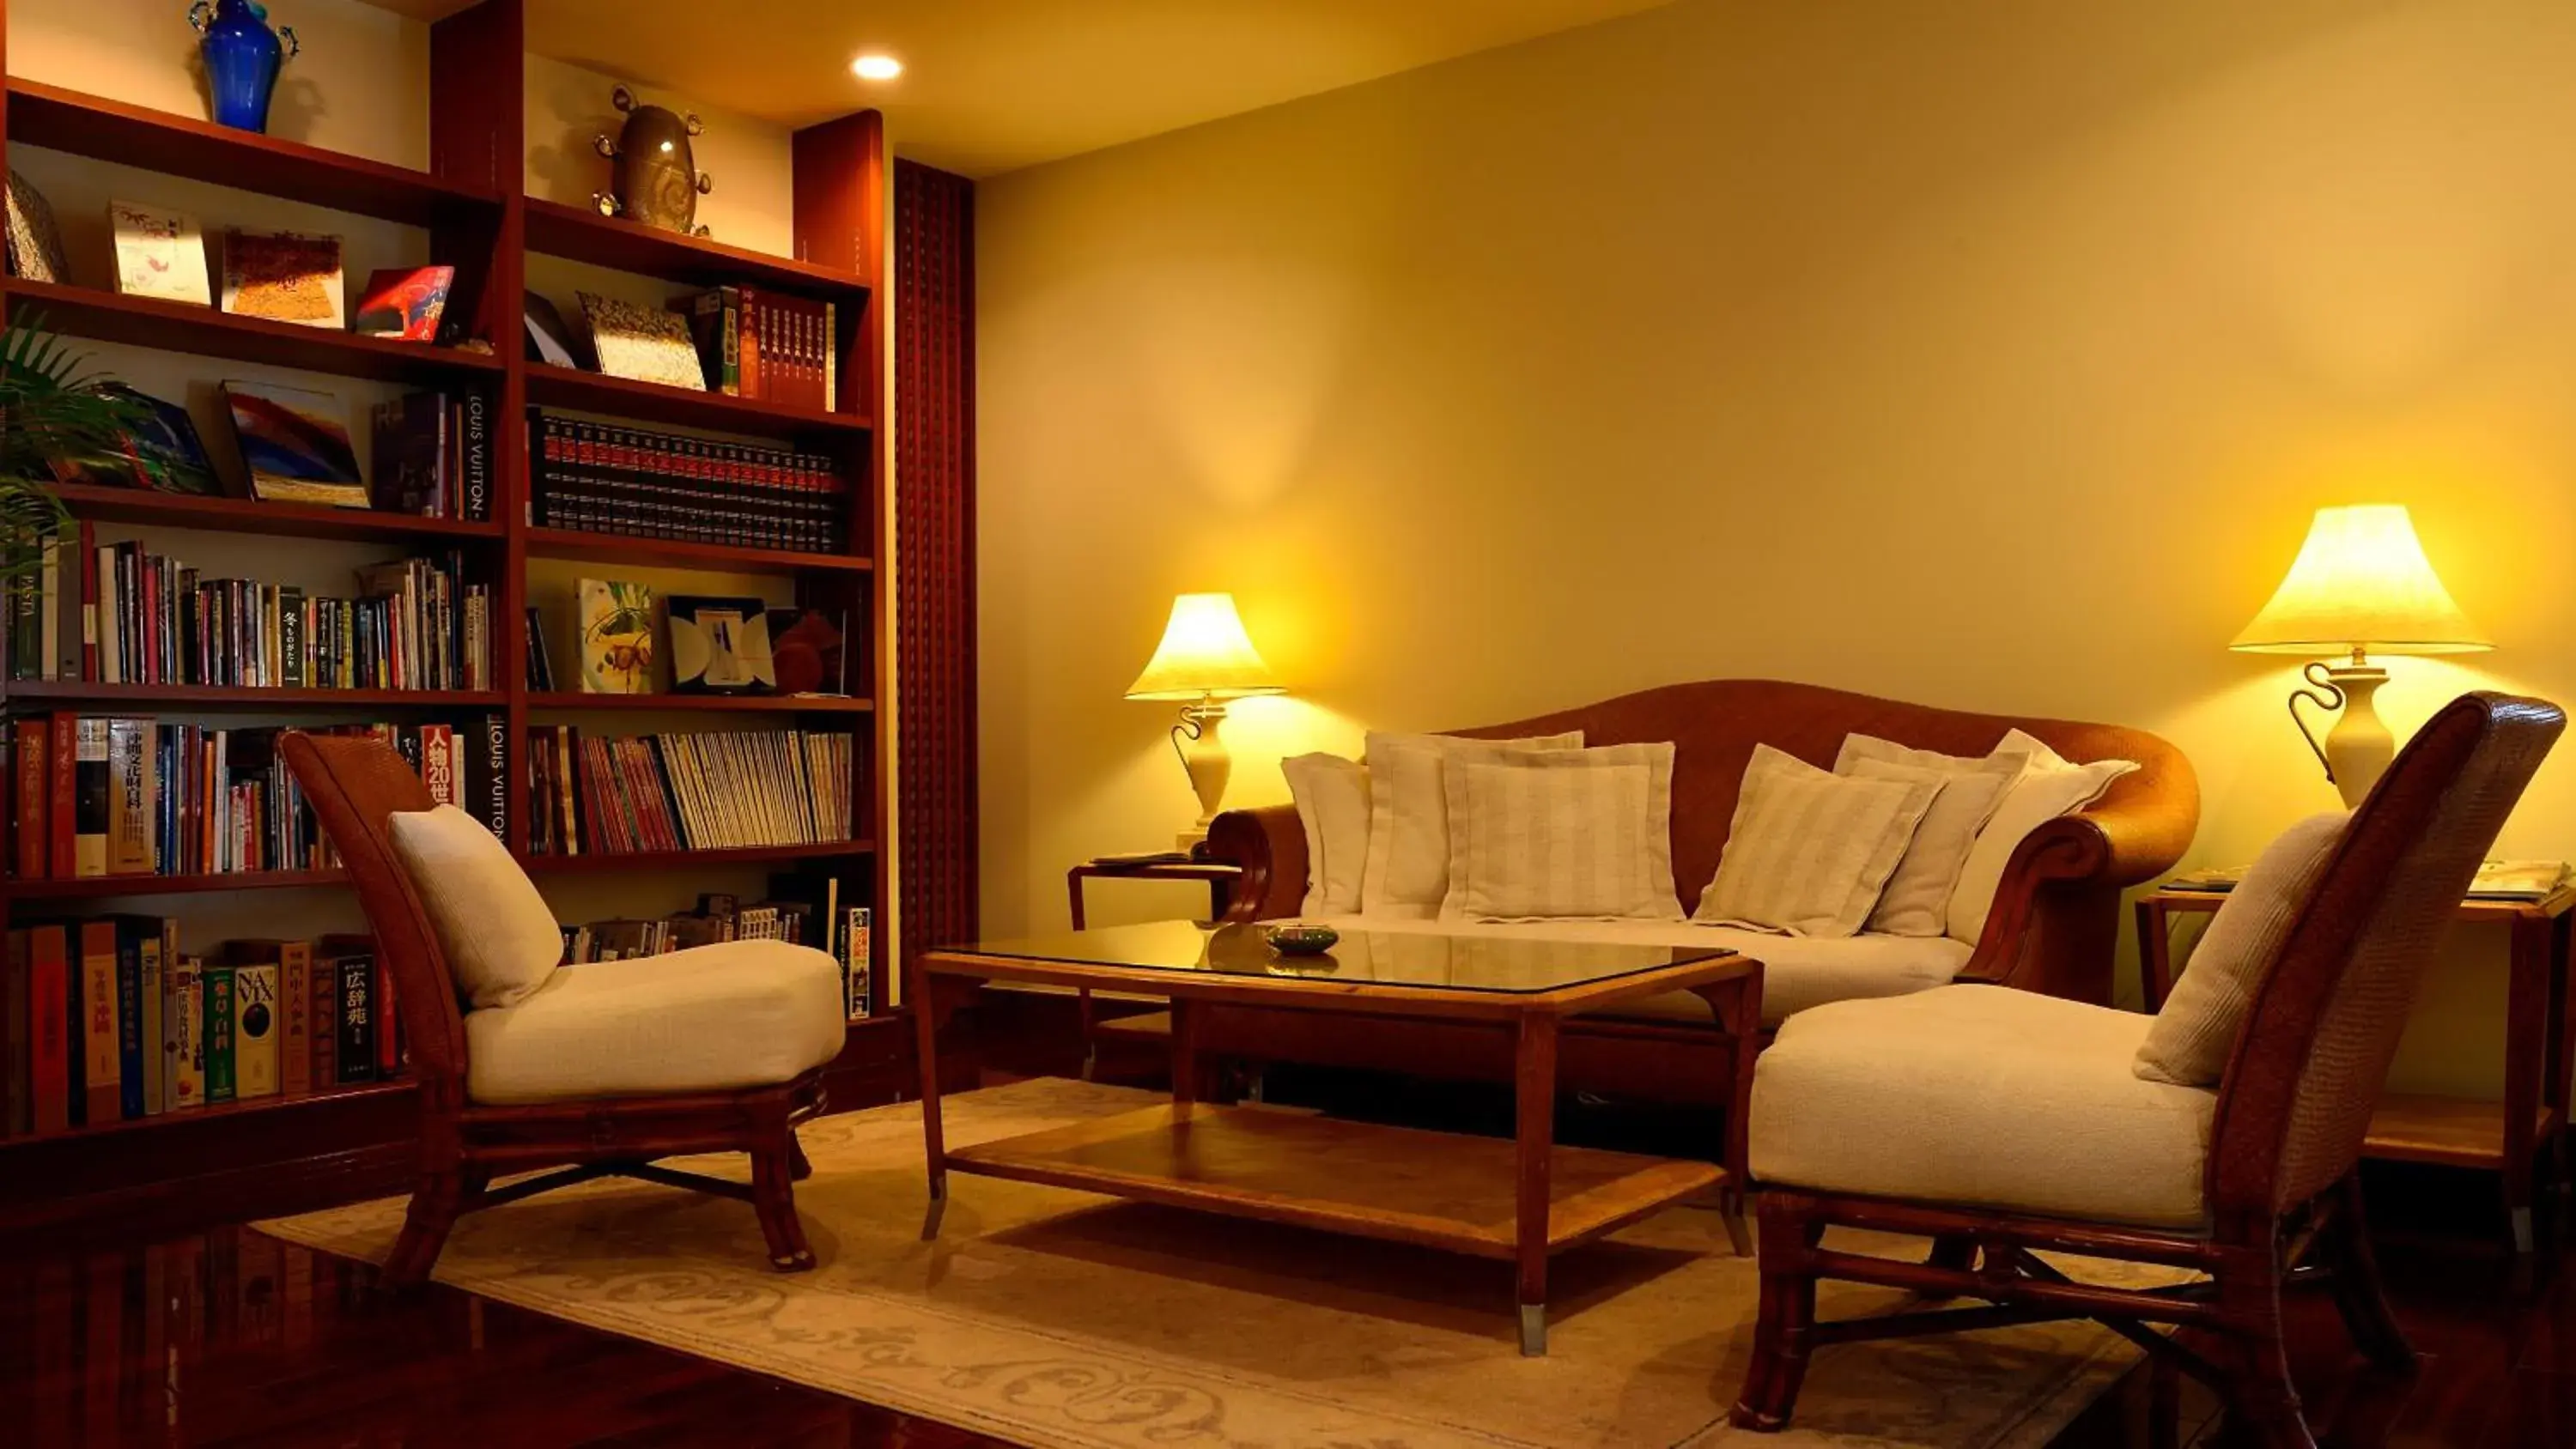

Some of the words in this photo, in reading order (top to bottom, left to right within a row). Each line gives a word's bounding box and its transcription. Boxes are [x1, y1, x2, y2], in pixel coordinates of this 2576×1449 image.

[470, 396, 484, 440] LOUIS
[471, 445, 485, 512] VUITTON
[20, 575, 35, 616] PASTA
[490, 724, 505, 769] LOUIS
[491, 774, 506, 843] VUITTON
[238, 972, 267, 988] NA
[344, 970, 370, 1027] 広辞苑
